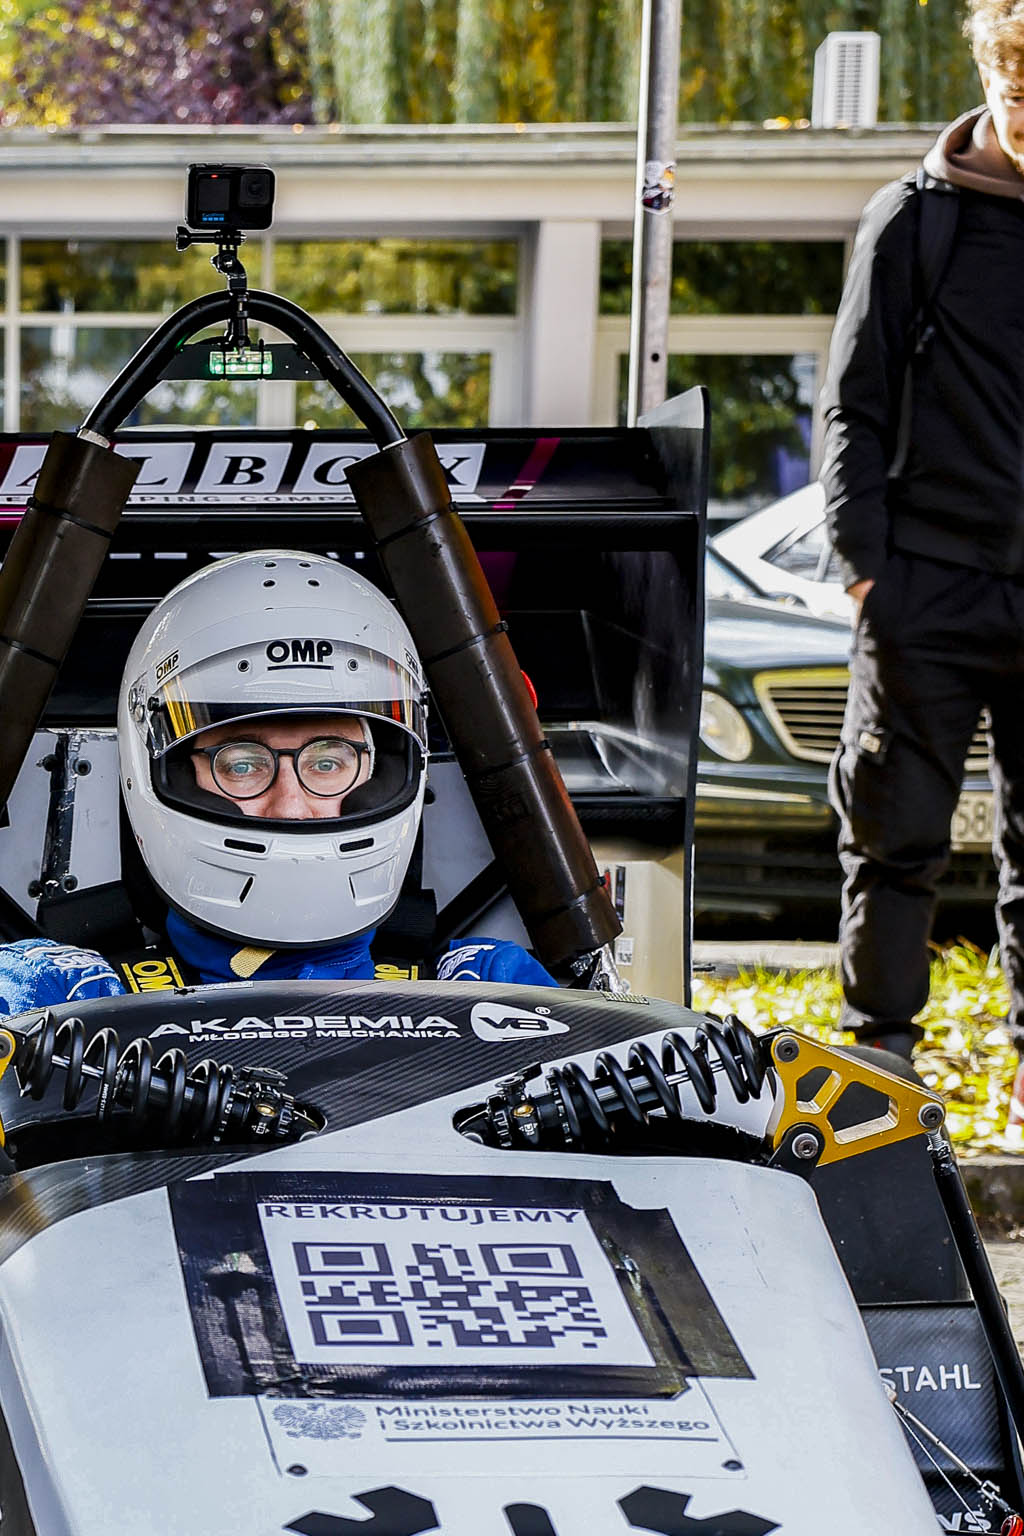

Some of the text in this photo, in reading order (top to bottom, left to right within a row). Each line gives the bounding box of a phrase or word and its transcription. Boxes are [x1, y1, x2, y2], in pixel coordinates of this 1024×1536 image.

[266, 640, 334, 662] OMP
[156, 653, 180, 681] OMP
[147, 1015, 459, 1040] AKADEMIA
[188, 1029, 462, 1043] MŁODEGO MECHANIKA
[264, 1204, 581, 1225] REKRUTUJEMY
[376, 1404, 650, 1418] Ministerstwo Nauki
[394, 1418, 561, 1431] Szkolnictwa
[566, 1416, 711, 1431] Wyższego
